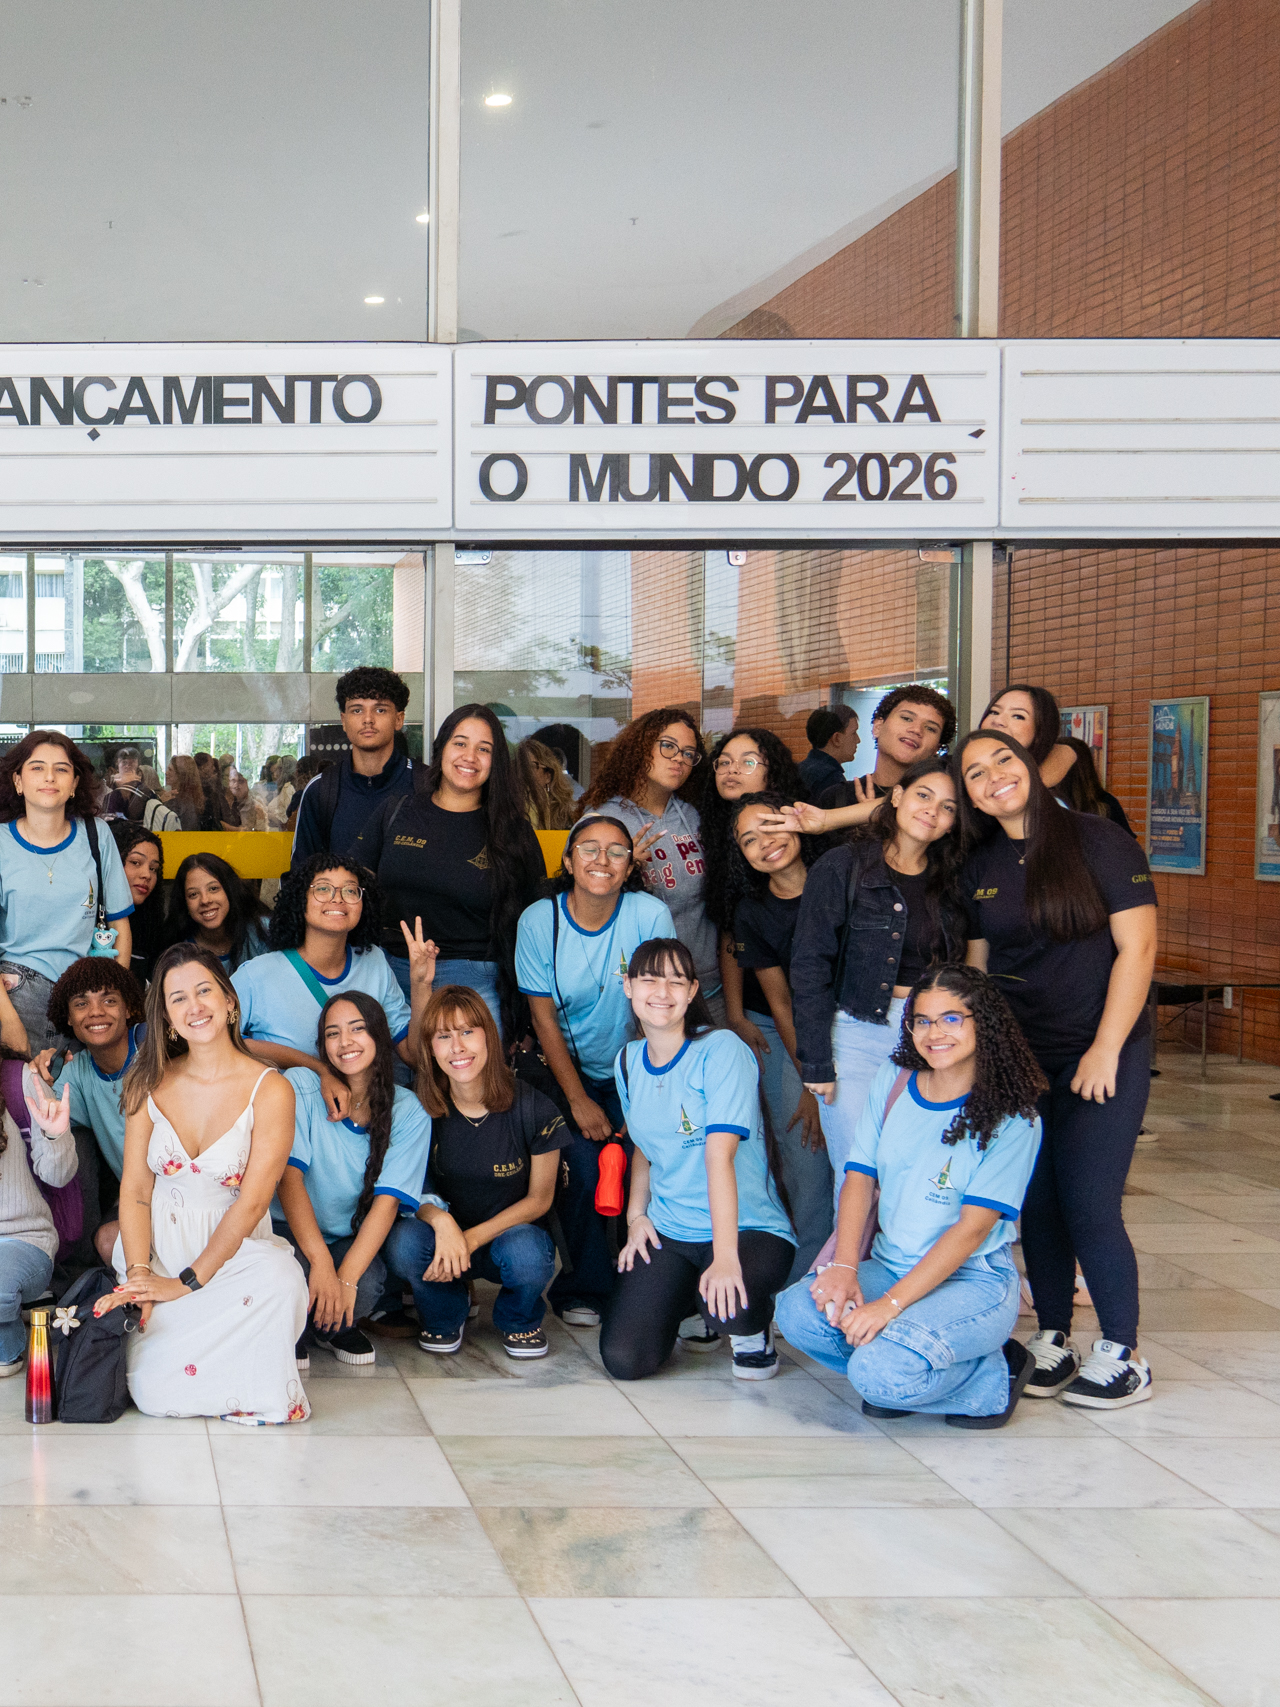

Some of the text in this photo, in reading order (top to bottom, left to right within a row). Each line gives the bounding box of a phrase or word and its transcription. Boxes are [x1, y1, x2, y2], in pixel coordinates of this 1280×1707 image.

[483, 373, 942, 425] PONTES PARA
[478, 451, 958, 503] O MUNDO 2026
